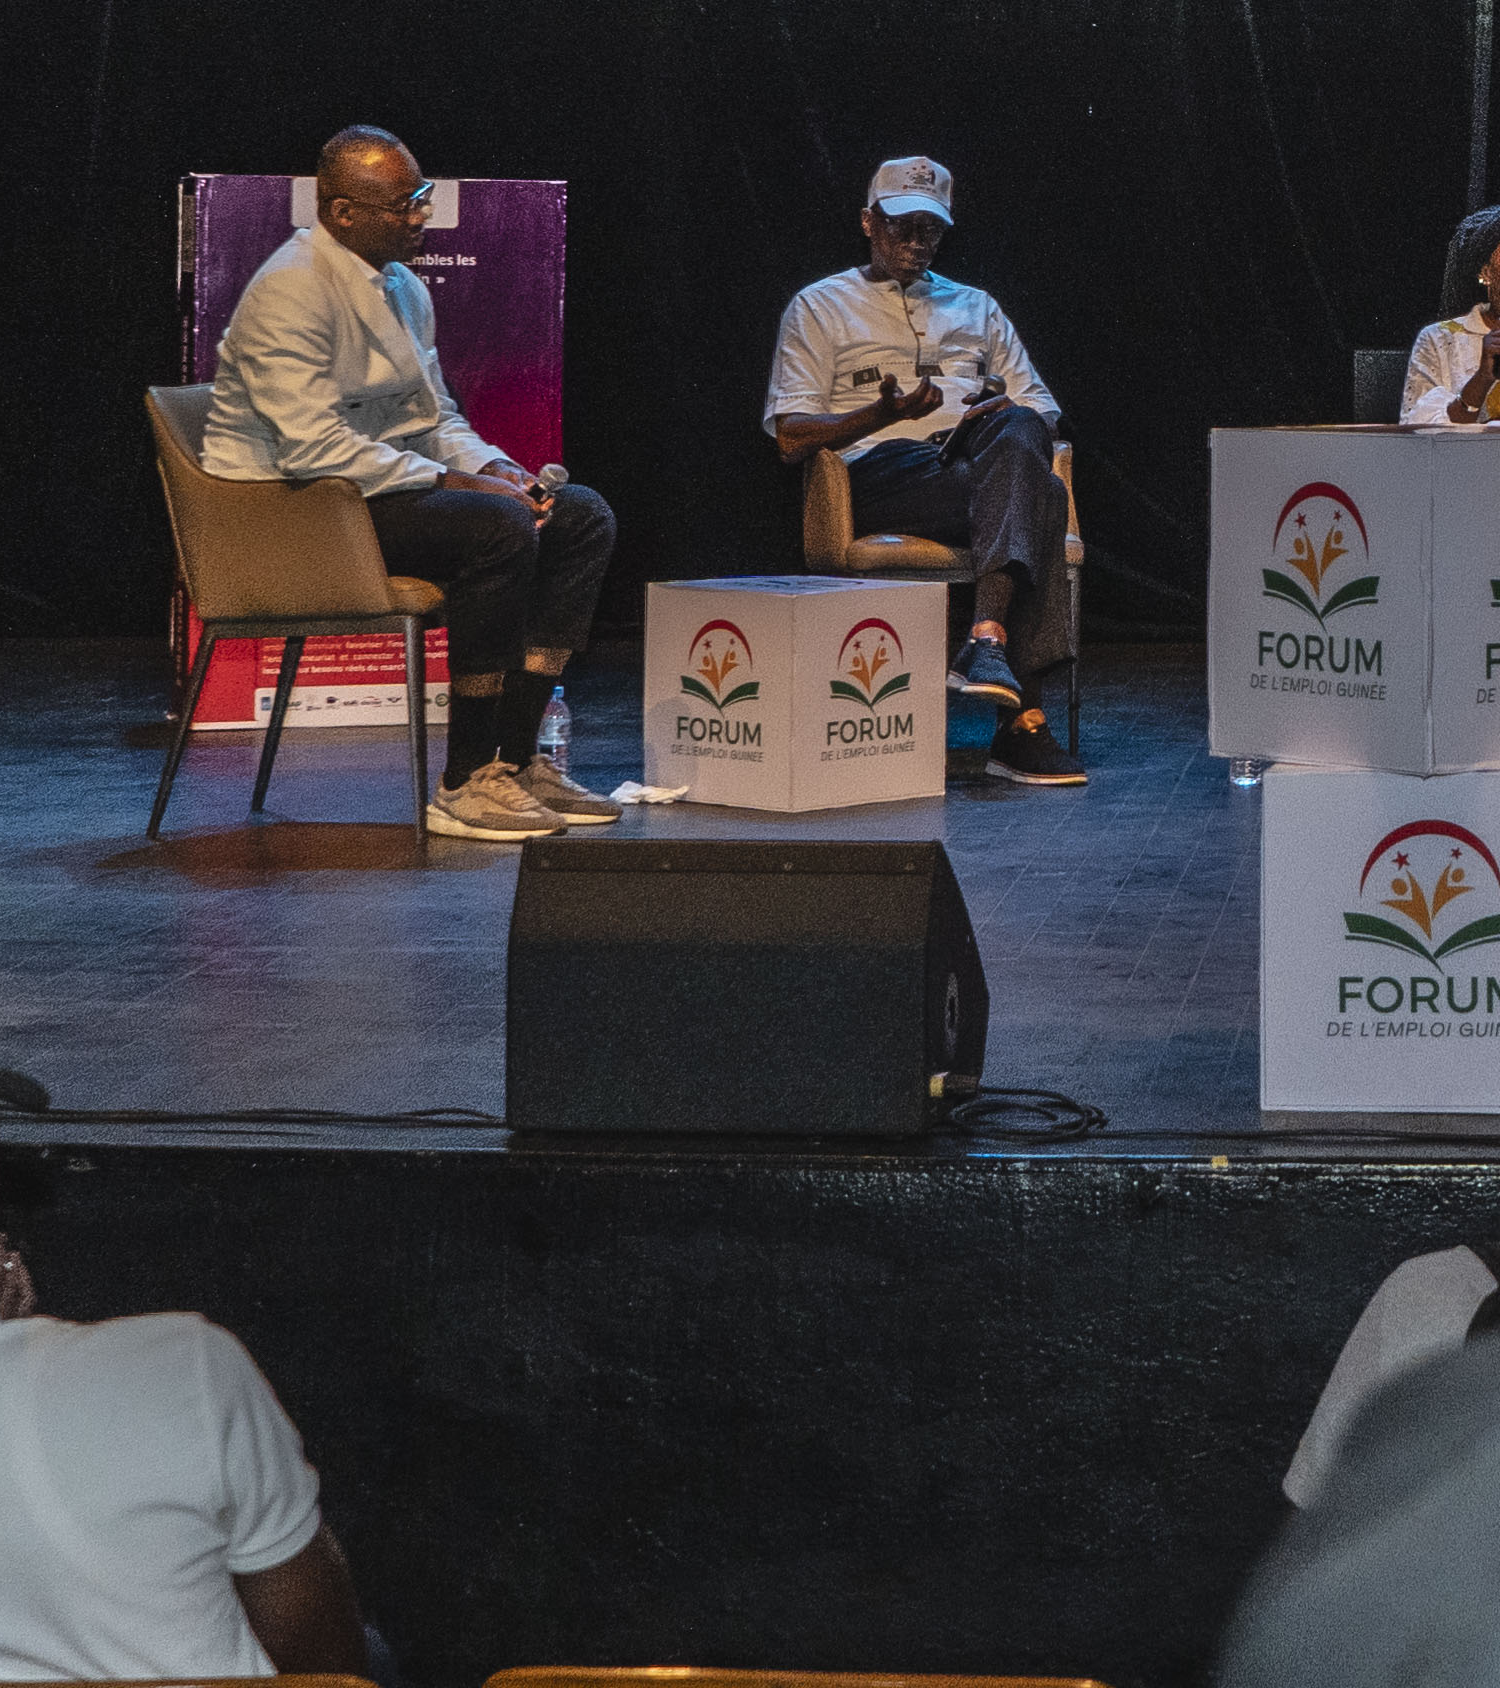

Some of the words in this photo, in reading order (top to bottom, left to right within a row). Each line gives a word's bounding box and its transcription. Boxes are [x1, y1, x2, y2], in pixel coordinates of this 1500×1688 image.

[405, 254, 454, 266] mbles
[456, 254, 477, 266] les
[1258, 630, 1384, 677] FORUM
[1250, 673, 1269, 691] DE
[1273, 676, 1333, 697] L'EMPLOI
[1336, 679, 1387, 702] GUINÉE
[1476, 687, 1498, 704] DE
[676, 715, 762, 747] FORUM
[827, 714, 914, 743] FORUM
[671, 743, 684, 756] DE
[686, 744, 728, 759] L'EMPLOI
[821, 749, 835, 762] DE
[837, 744, 880, 760] L'EMPLOI
[1326, 1022, 1353, 1038] DE
[1360, 1022, 1452, 1038] L'EMPLOI
